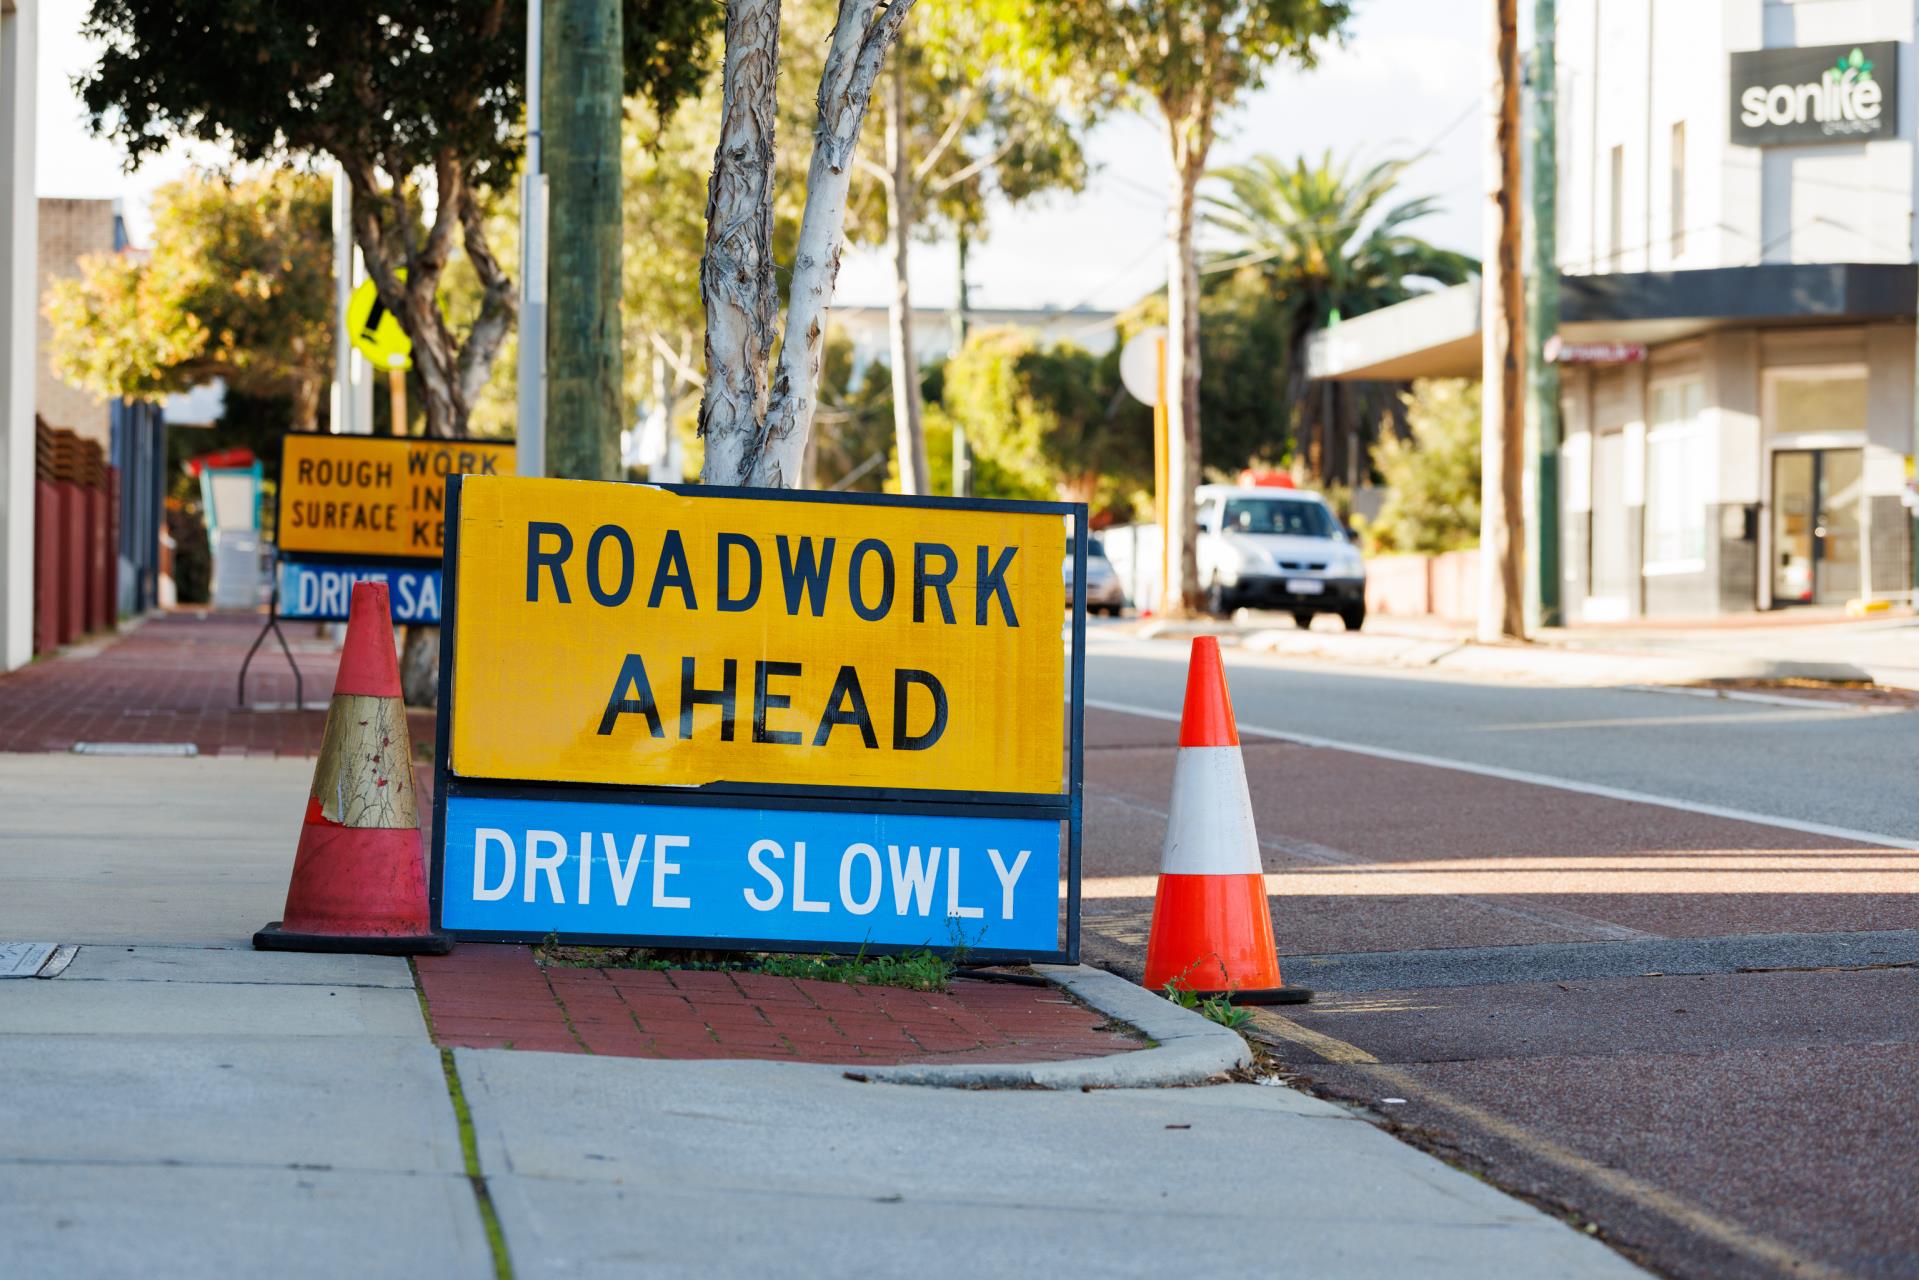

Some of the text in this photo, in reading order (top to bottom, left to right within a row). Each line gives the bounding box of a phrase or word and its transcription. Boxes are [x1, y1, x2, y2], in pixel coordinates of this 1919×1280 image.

[1740, 66, 1882, 127] sonlife
[298, 457, 393, 488] ROUGH
[407, 449, 498, 475] WORK
[291, 500, 397, 532] SURFACE
[411, 485, 443, 513] IN
[301, 571, 442, 619] DRI SA
[526, 521, 1020, 628] ROADWORK
[596, 653, 949, 751] AHEAD
[472, 827, 1032, 920] DRIVE SLOWLY
